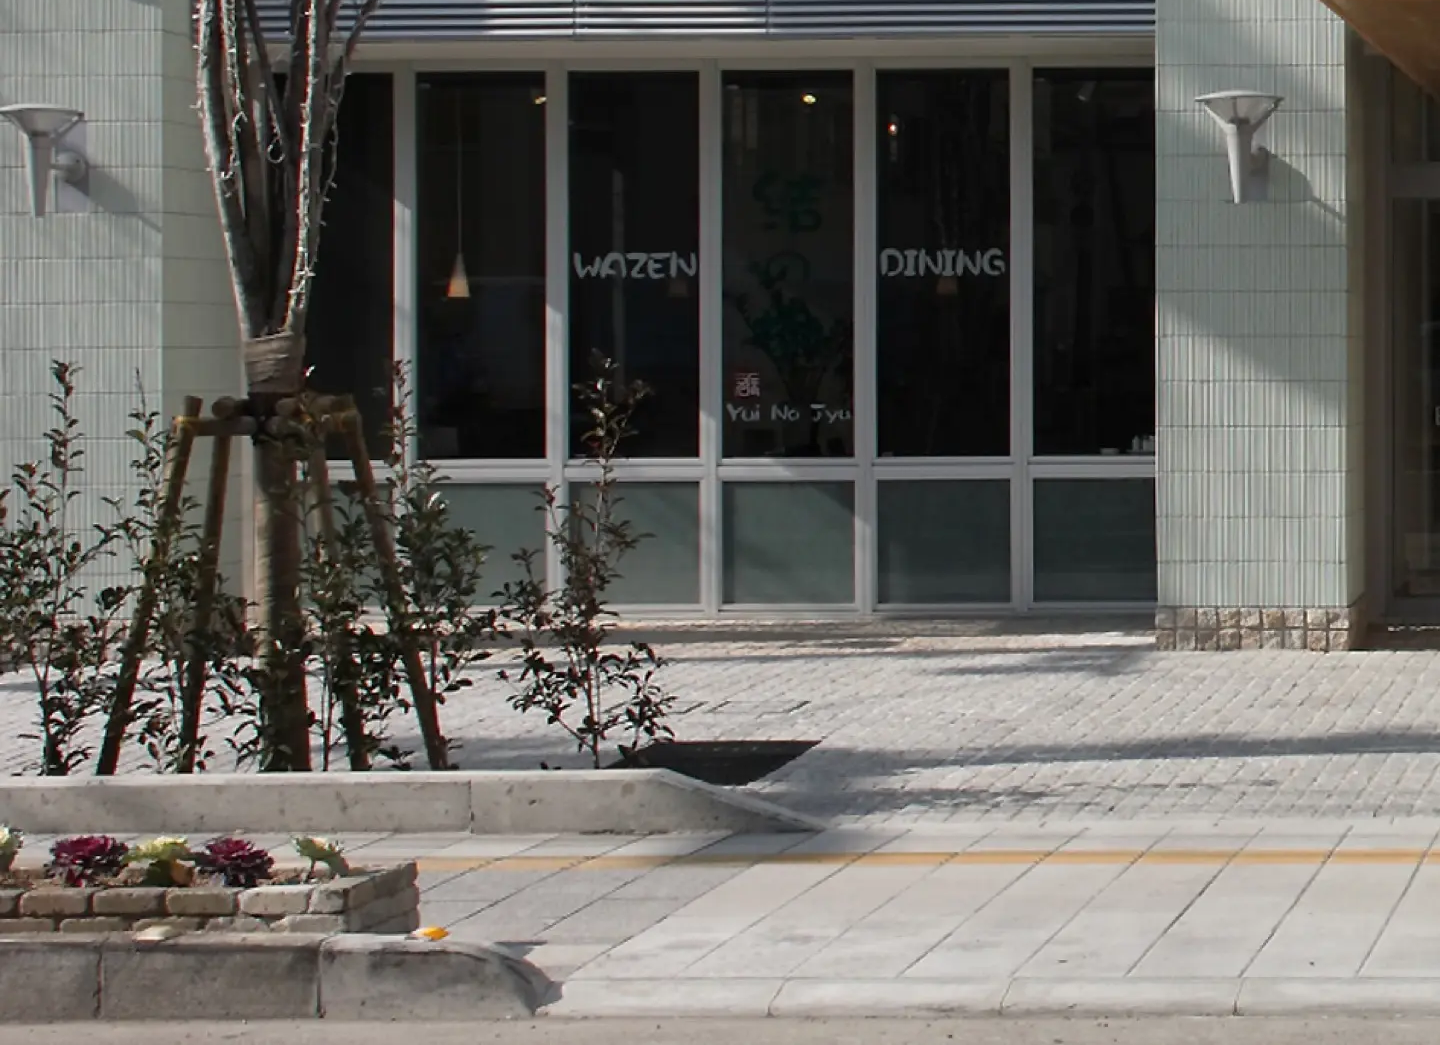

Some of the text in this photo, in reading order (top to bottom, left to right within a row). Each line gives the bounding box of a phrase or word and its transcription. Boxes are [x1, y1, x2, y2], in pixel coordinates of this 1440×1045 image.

[572, 247, 1006, 279] WAZEN DINING
[725, 402, 852, 424] Yui No Jyu
